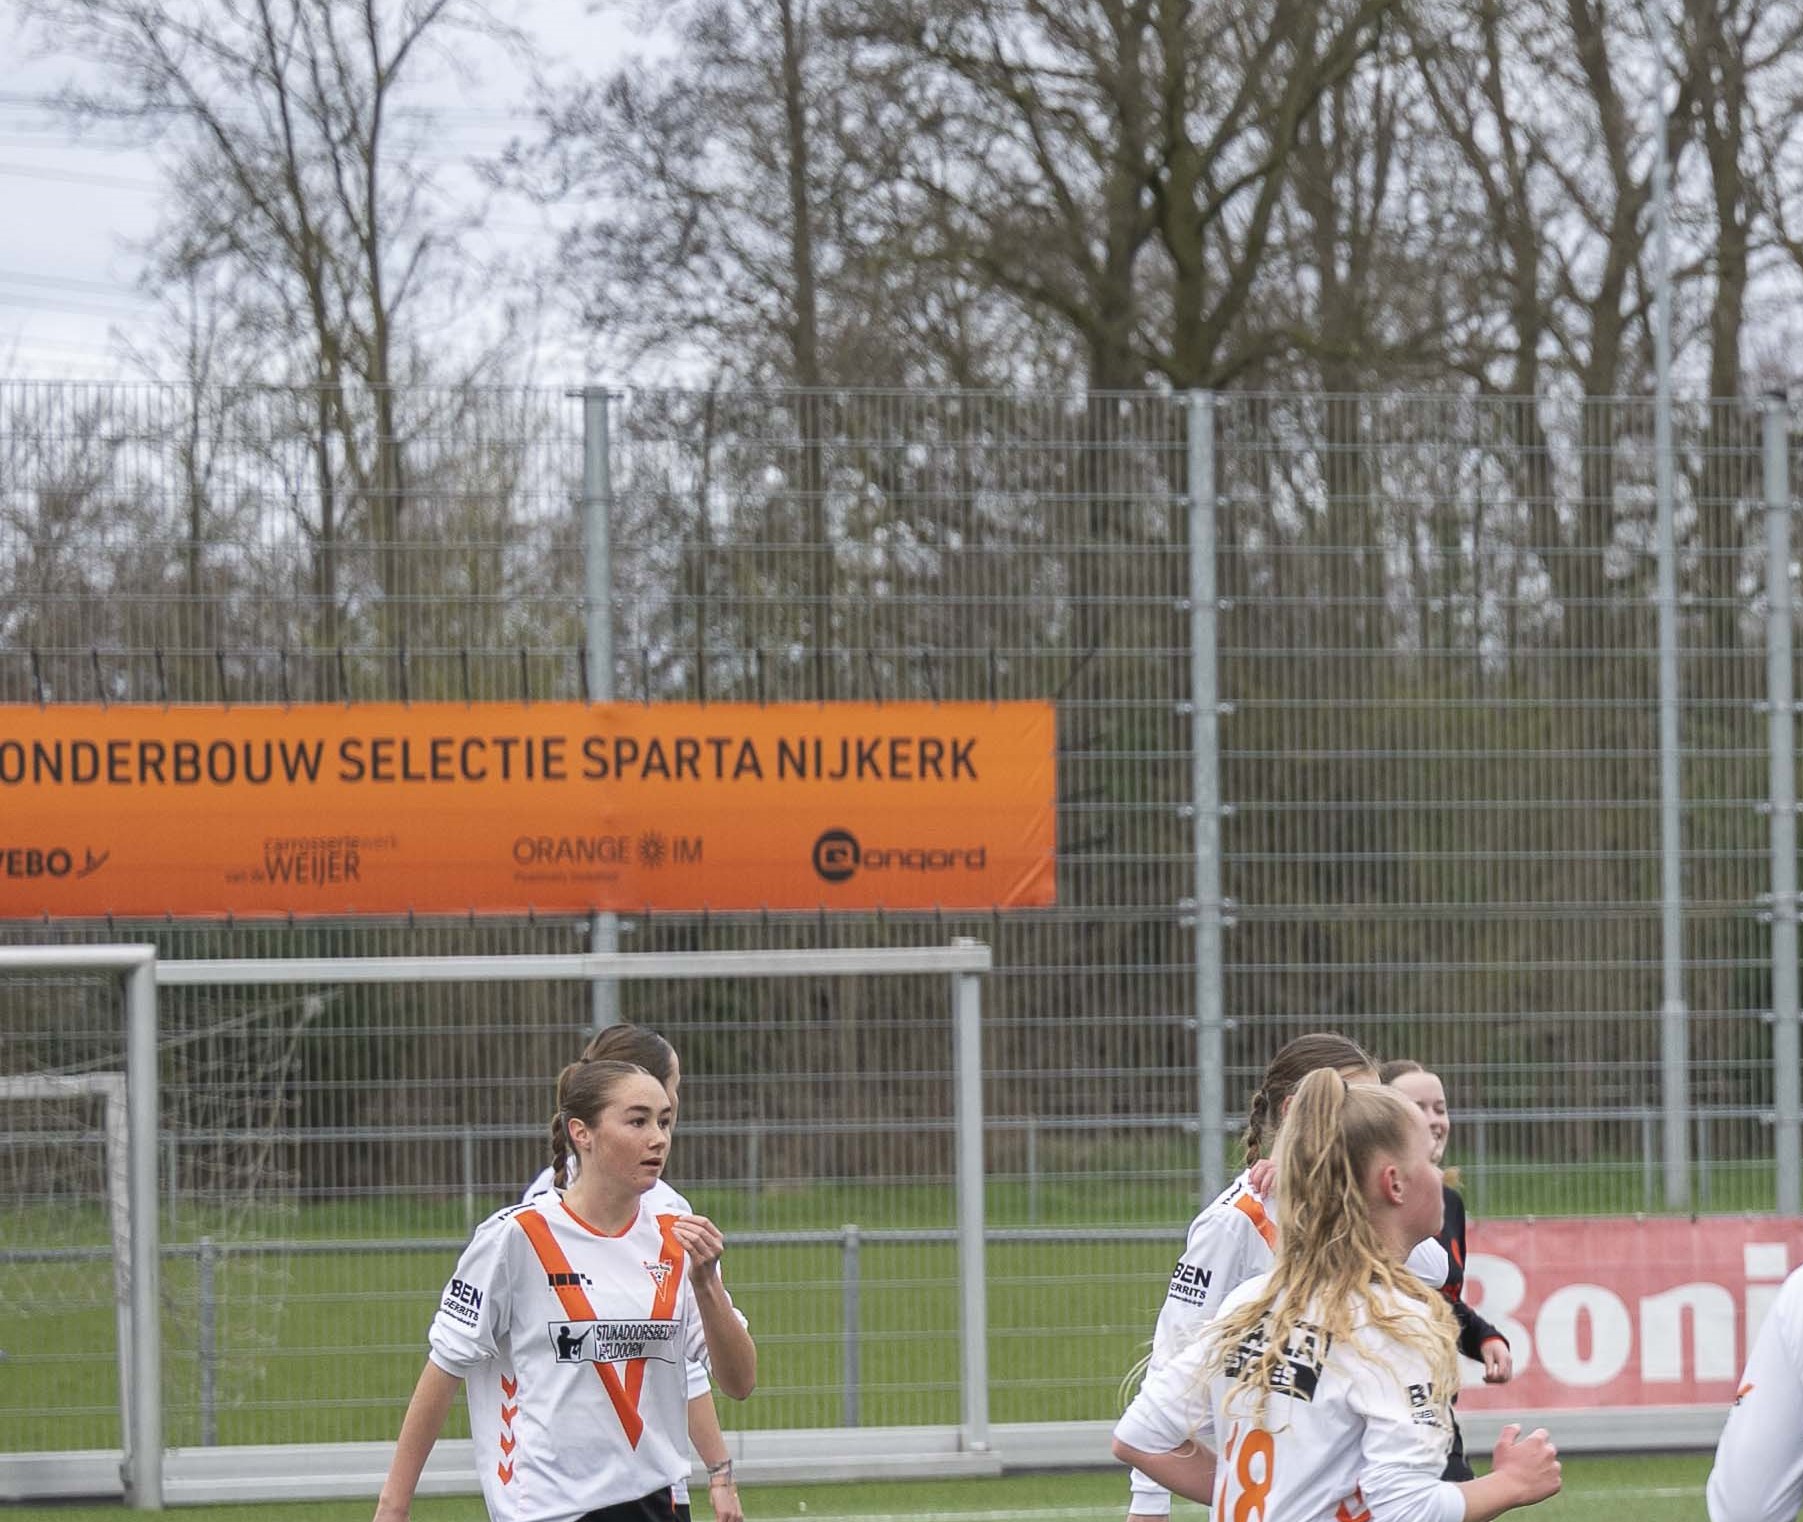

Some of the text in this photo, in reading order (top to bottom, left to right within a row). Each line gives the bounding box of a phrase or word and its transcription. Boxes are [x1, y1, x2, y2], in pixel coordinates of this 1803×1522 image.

[0, 737, 979, 785] ONDERBOUW SELECTIE SPARTA NIJKERK
[512, 835, 632, 865] ORANGE
[1172, 1262, 1213, 1289] BEN
[450, 1279, 484, 1310] BEN
[1169, 1282, 1206, 1300] ERRITS
[1461, 1242, 1790, 1387] Boni
